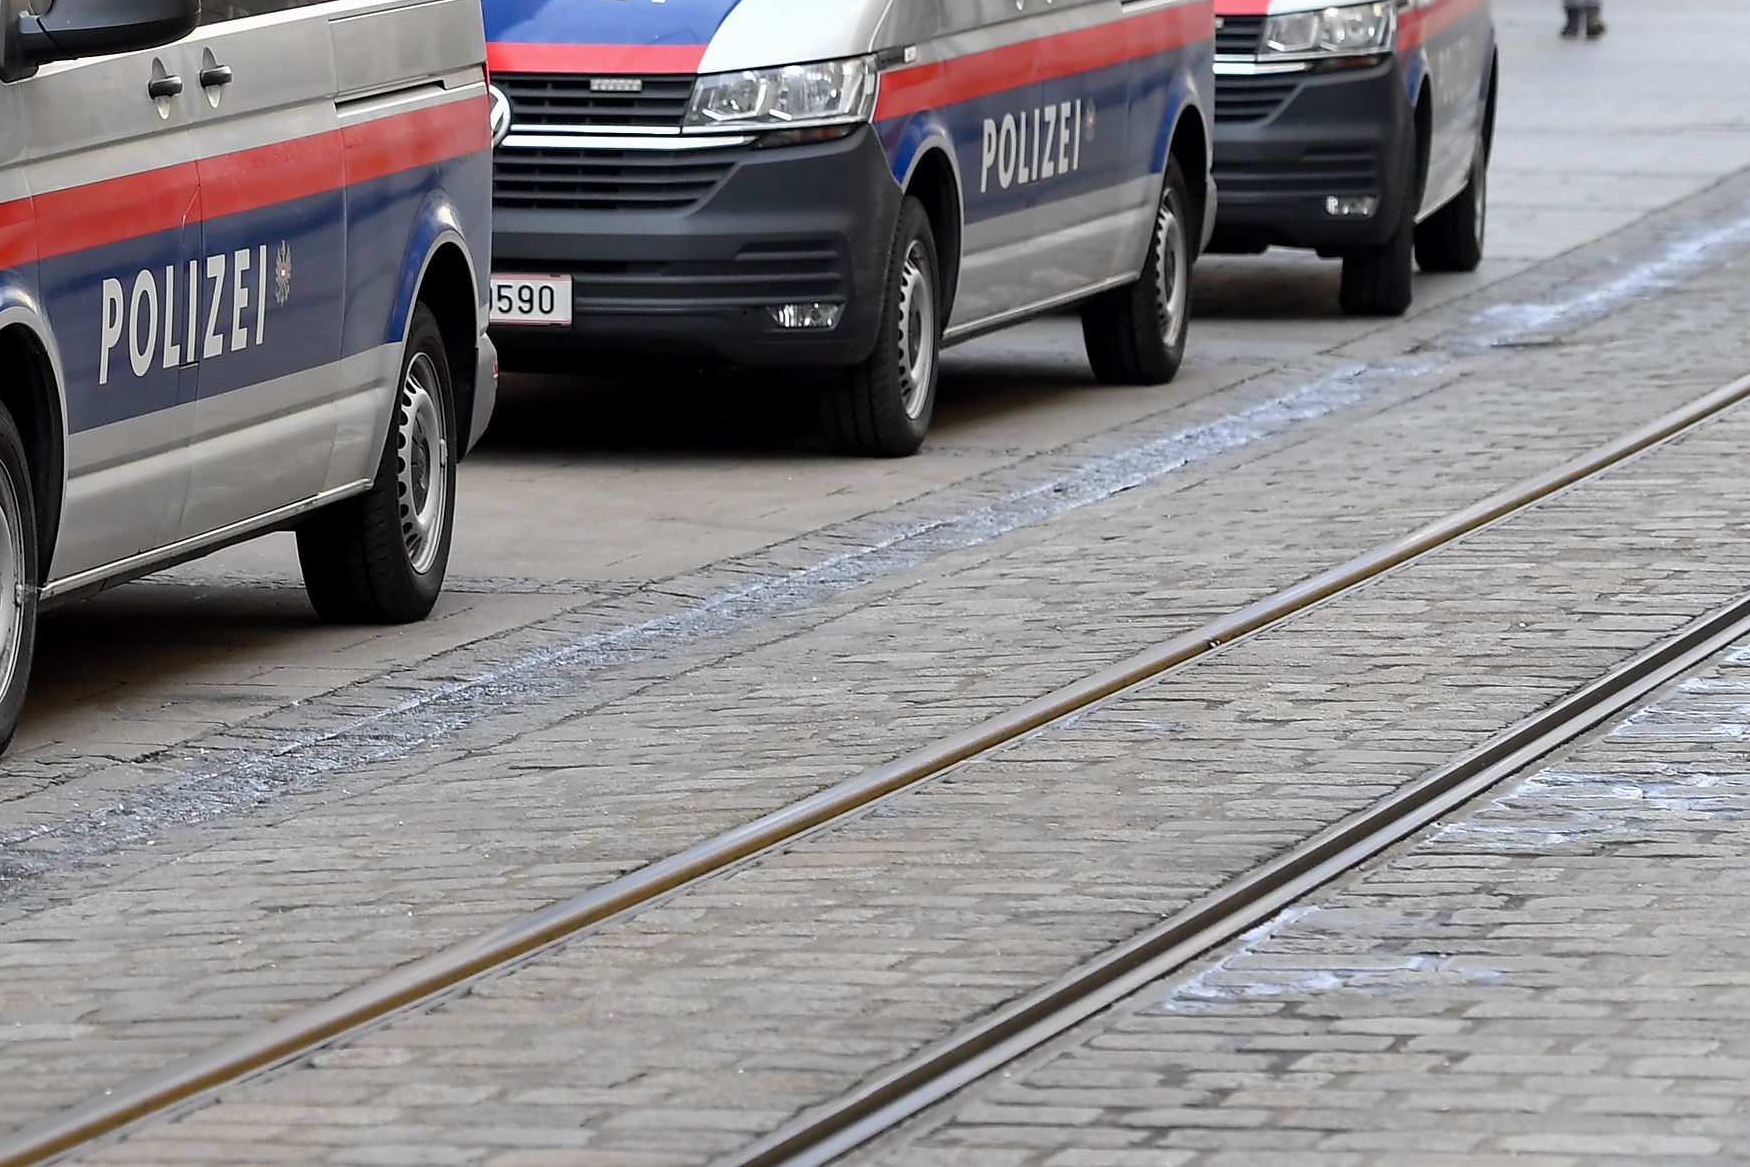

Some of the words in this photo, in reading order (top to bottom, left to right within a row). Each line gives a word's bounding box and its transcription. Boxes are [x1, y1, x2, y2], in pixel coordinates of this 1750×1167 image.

[980, 98, 1082, 194] POLIZEI
[99, 243, 268, 386] POLIZEI
[490, 284, 555, 315] 590
